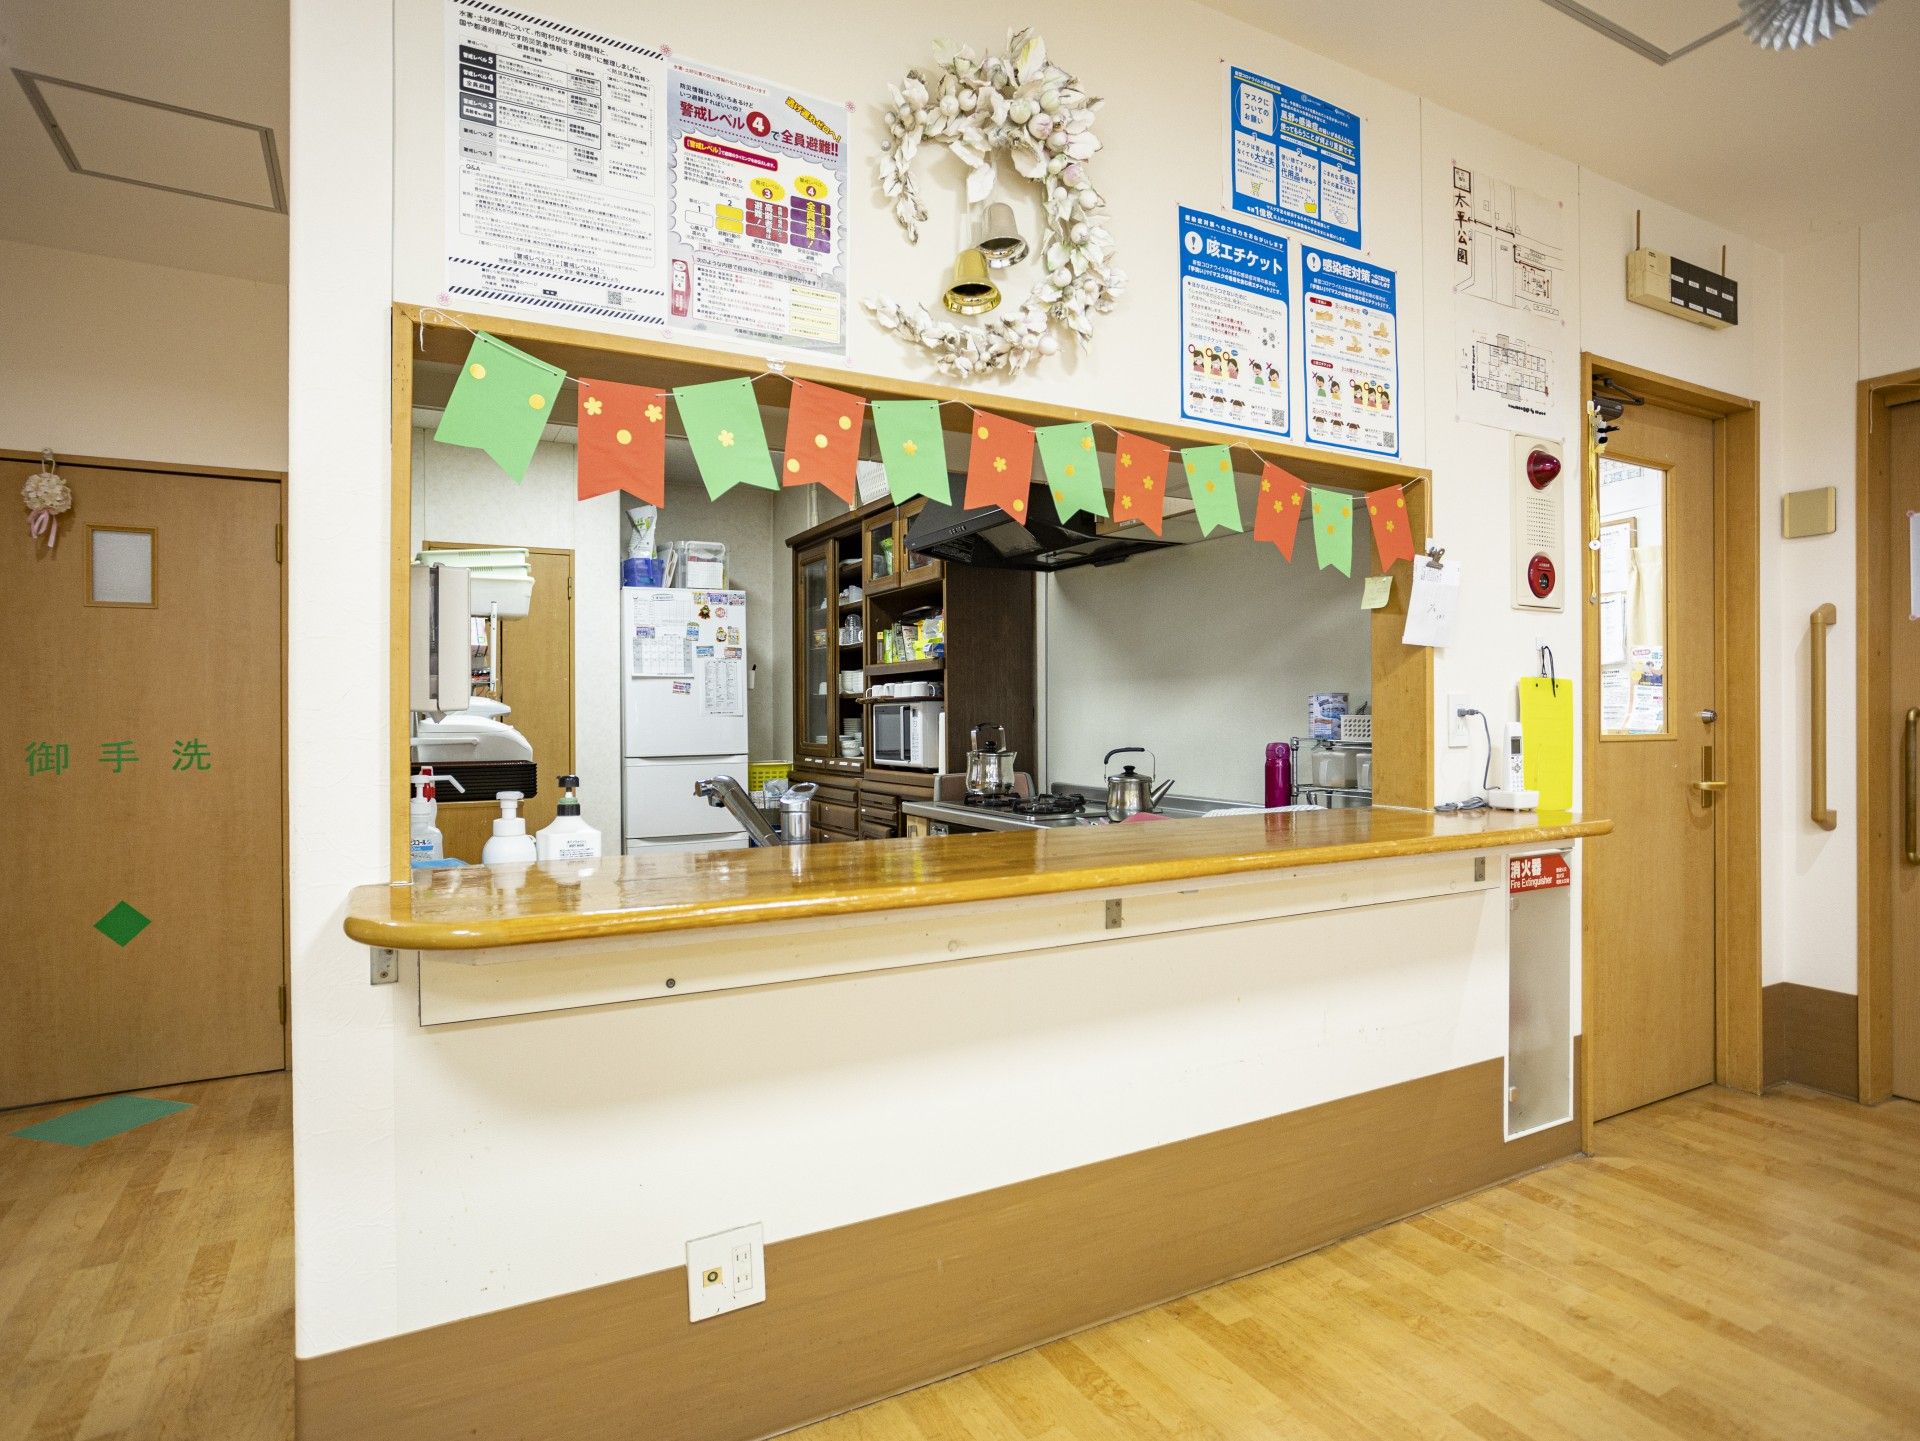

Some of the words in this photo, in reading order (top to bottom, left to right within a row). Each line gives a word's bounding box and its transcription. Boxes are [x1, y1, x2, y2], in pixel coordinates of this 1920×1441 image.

[679, 82, 753, 108] 防災情報はいろいろあるけど
[1244, 92, 1268, 107] マスクに
[1244, 103, 1270, 117] ついての
[1244, 113, 1263, 125] お願い
[1236, 148, 1275, 166] なくても大丈夫
[764, 189, 771, 199] 3
[1185, 215, 1284, 249] 感染症対策へのご協力をおねがいします
[1455, 191, 1471, 265] 太平公園
[1206, 238, 1283, 275] 咳エチケット
[1322, 258, 1371, 284] 感染症対策
[23, 736, 213, 776] 御手洗
[1510, 857, 1542, 879] 消火器
[1511, 879, 1521, 889] Fire
[1521, 875, 1553, 888] Extinguisher
